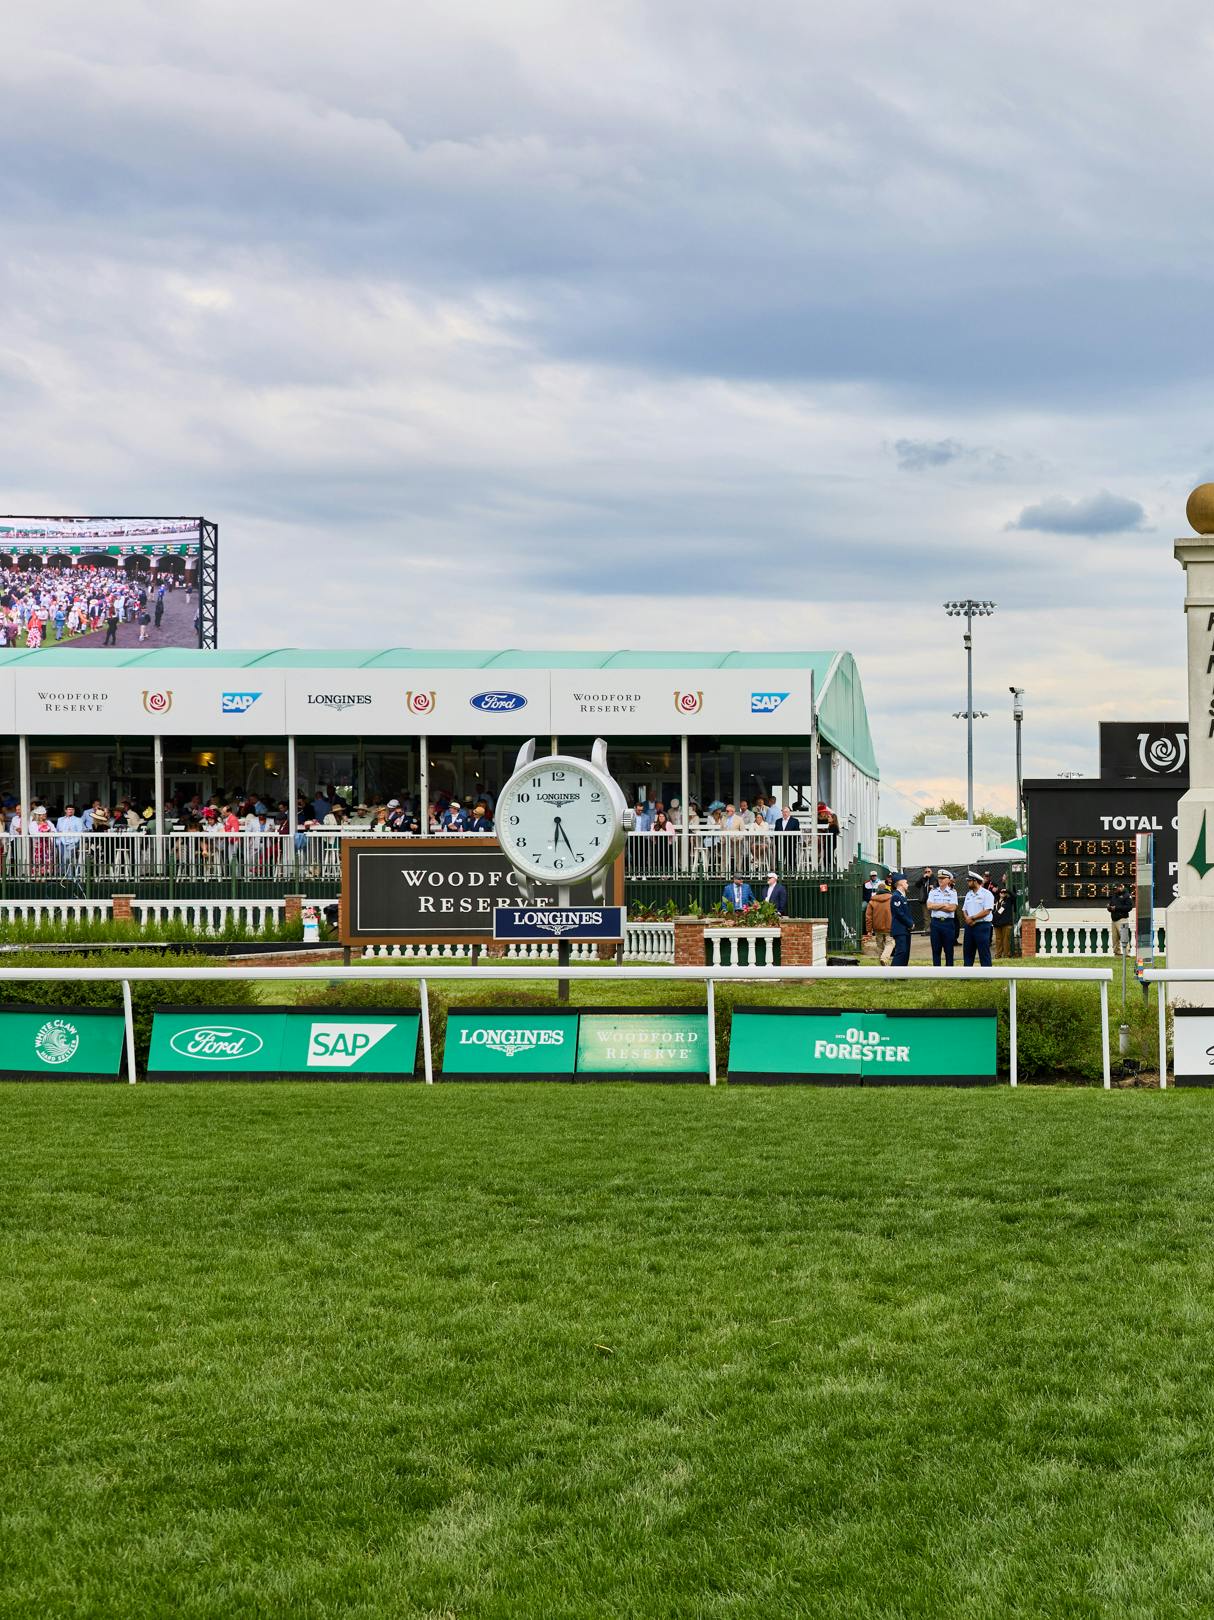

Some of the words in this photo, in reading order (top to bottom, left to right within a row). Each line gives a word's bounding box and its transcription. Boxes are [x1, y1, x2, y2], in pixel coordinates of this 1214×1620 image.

[38, 692, 108, 700] WOODFORD
[223, 695, 254, 710] SAP
[307, 694, 372, 705] LONGINES
[481, 694, 516, 709] Ford
[573, 693, 641, 702] WOODFORD
[751, 695, 781, 710] SAP
[45, 703, 103, 712] RESERVE
[580, 704, 636, 713] RESERVE
[536, 793, 581, 801] LONGINES
[1100, 816, 1163, 830] TOTAL
[402, 870, 554, 886] WOODFO
[514, 912, 602, 925] LONGINES
[35, 1022, 53, 1048] WHITE
[53, 1020, 77, 1034] CLAW
[459, 1029, 564, 1045] LONGINES
[597, 1031, 698, 1042] WOODFORD
[846, 1028, 880, 1045] OLD
[187, 1030, 246, 1055] Ford
[313, 1033, 370, 1056] SAP
[814, 1040, 910, 1062] FORESTER
